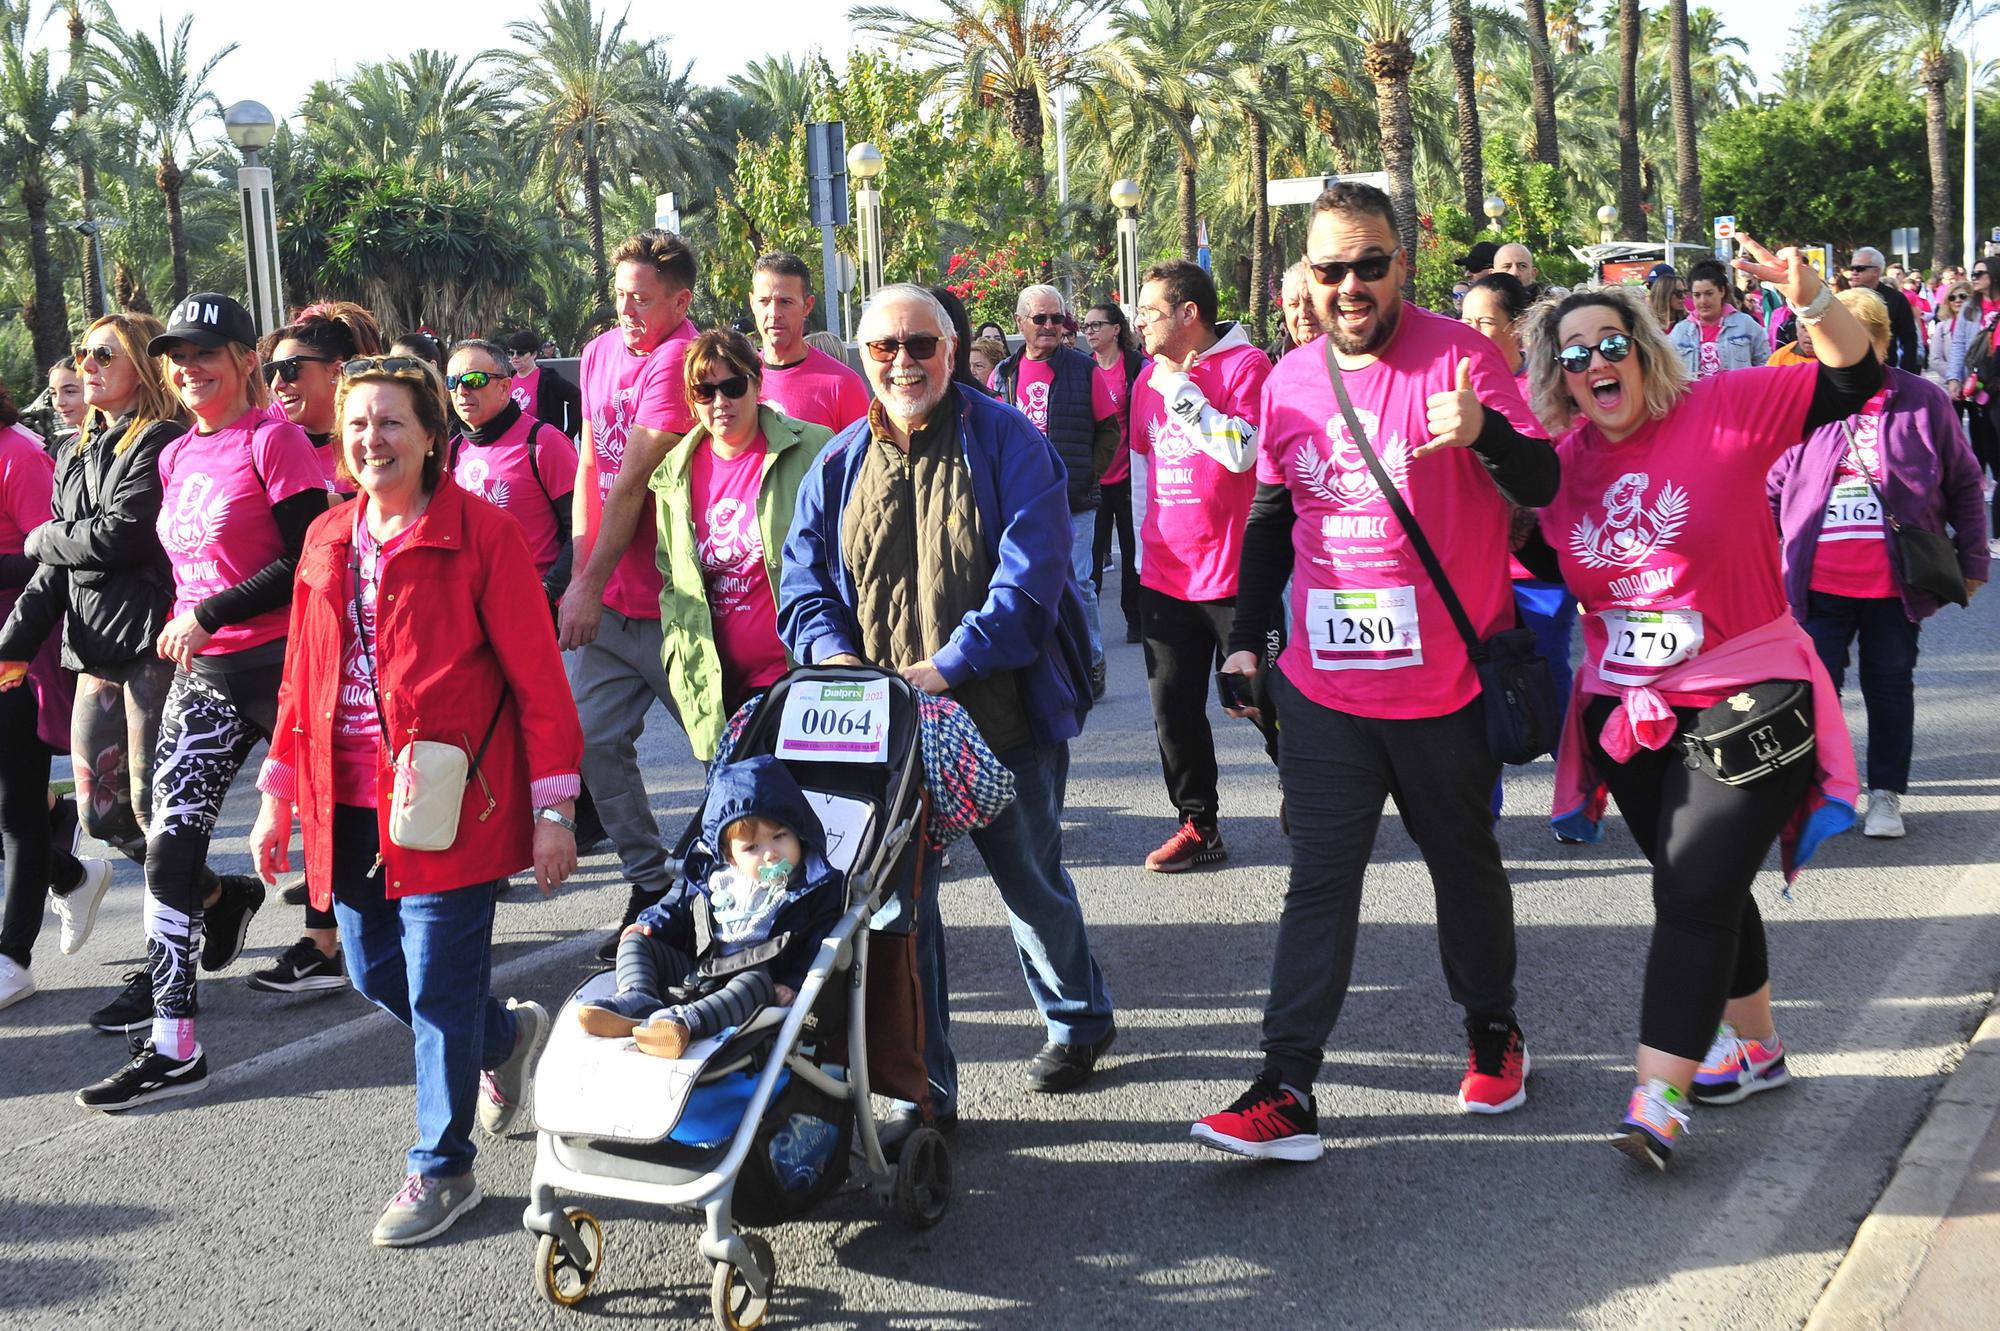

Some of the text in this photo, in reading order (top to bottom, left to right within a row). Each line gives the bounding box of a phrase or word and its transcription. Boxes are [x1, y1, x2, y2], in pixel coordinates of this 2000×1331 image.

[1827, 503, 1878, 522] 5162
[1324, 617, 1395, 644] 1280
[1613, 629, 1678, 659] 1279
[823, 689, 864, 700] Dialprix
[801, 708, 872, 735] 0064
